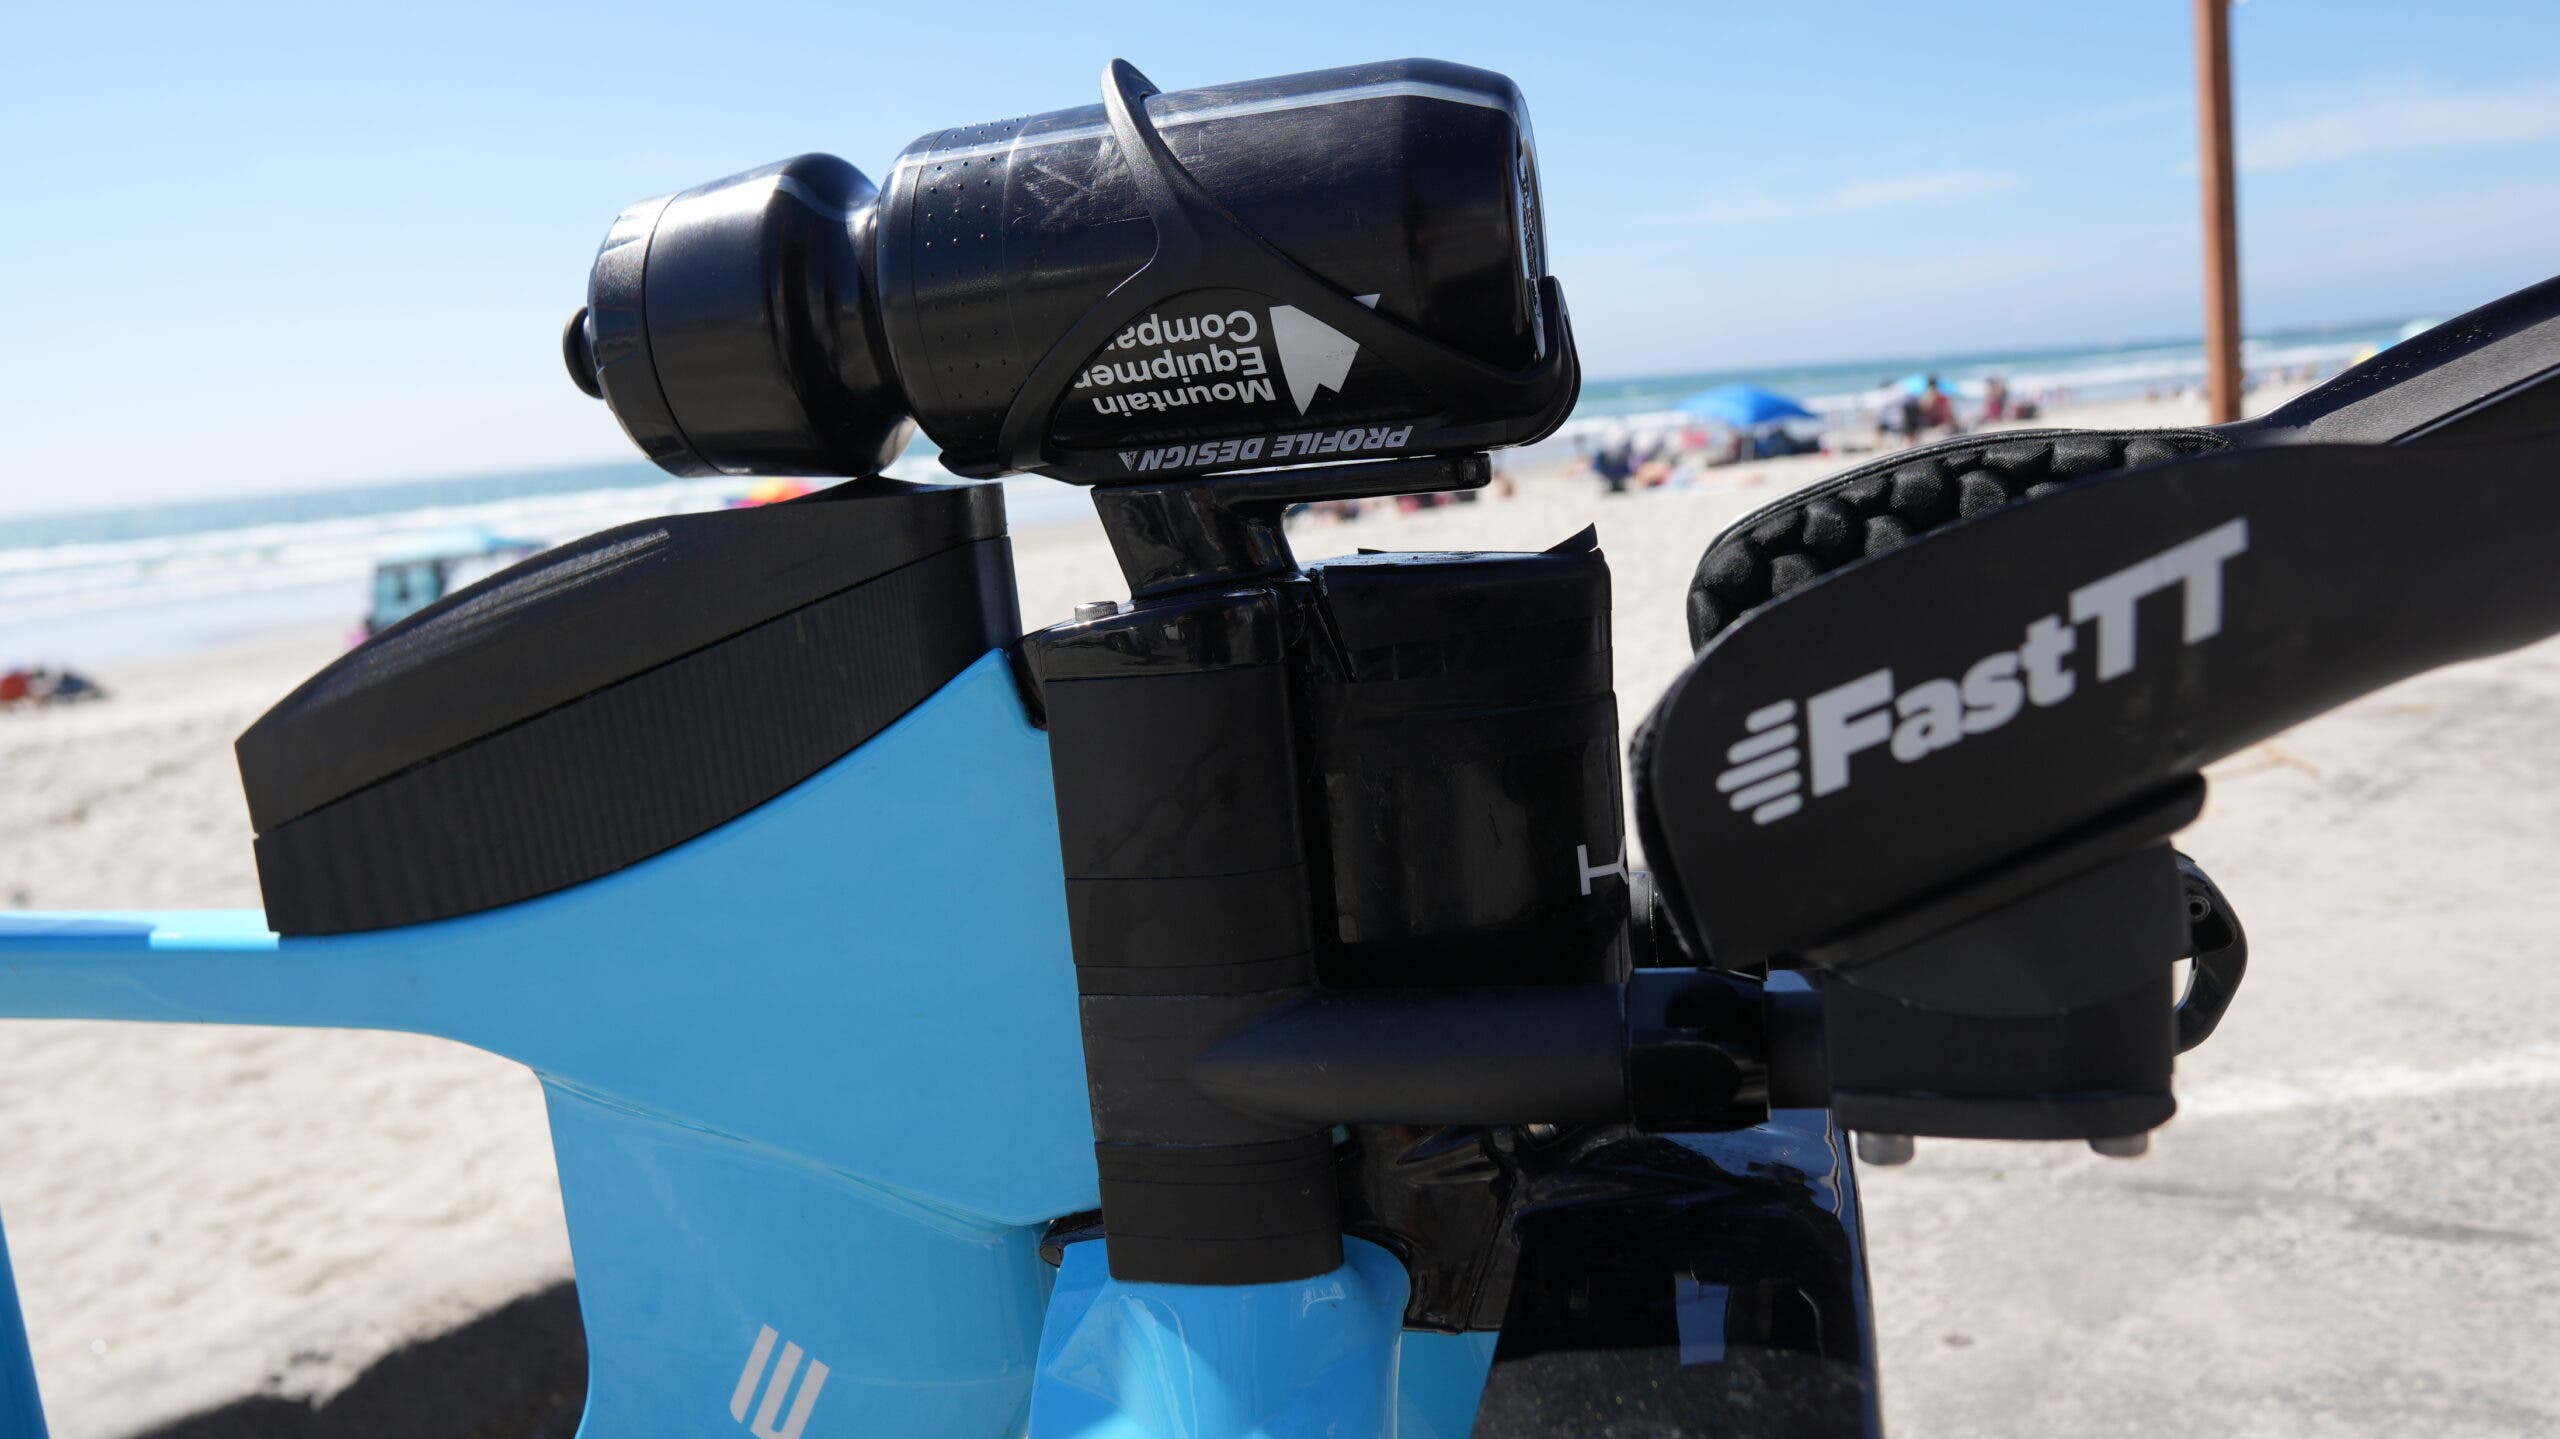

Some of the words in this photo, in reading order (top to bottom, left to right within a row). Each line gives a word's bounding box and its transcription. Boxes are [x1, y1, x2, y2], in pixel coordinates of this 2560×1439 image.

[1104, 310, 1258, 351] Compa
[1092, 377, 1277, 417] Mountain
[1137, 438, 1265, 471] DESIGN
[1270, 425, 1413, 458] PROFILE
[1807, 516, 2248, 798] FastTT
